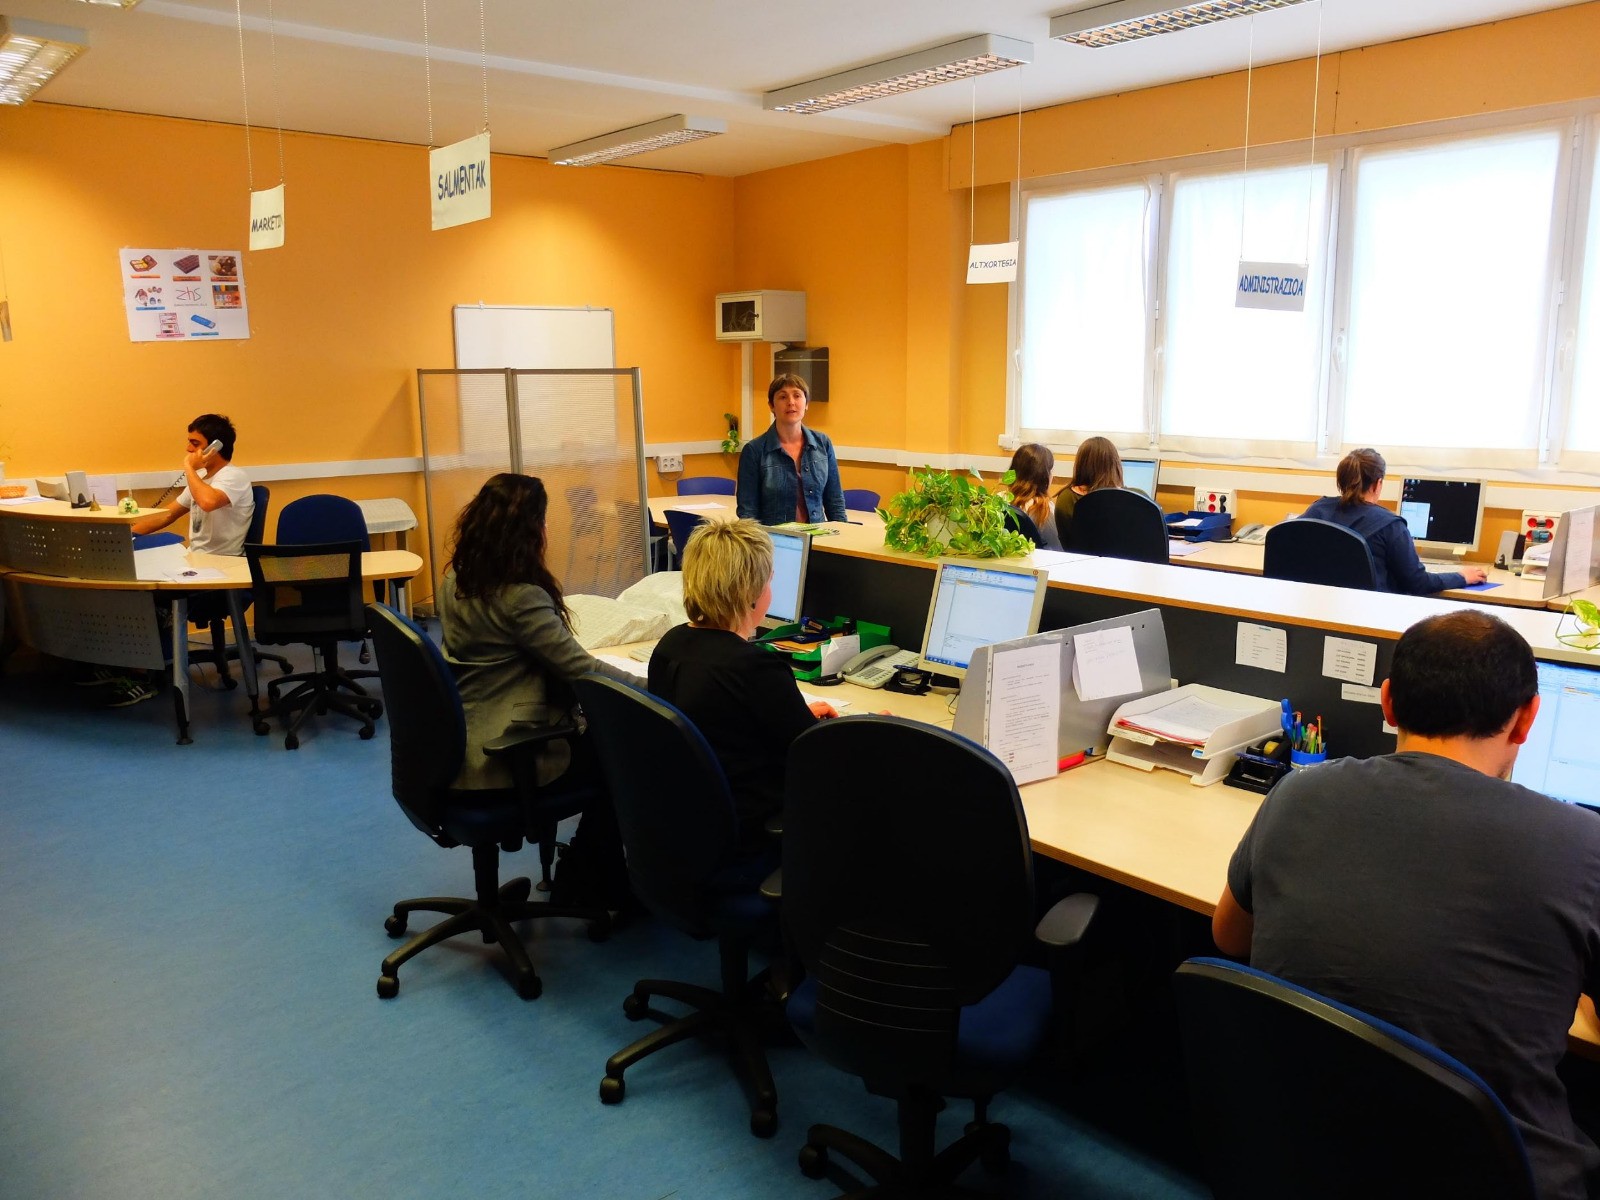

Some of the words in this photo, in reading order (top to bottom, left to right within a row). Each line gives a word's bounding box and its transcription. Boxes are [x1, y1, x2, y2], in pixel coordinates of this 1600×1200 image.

[438, 159, 486, 200] SALMENTAK
[970, 259, 1016, 268] ALTXORTEGIA
[1239, 274, 1304, 296] ADMINISTRAZIOA
